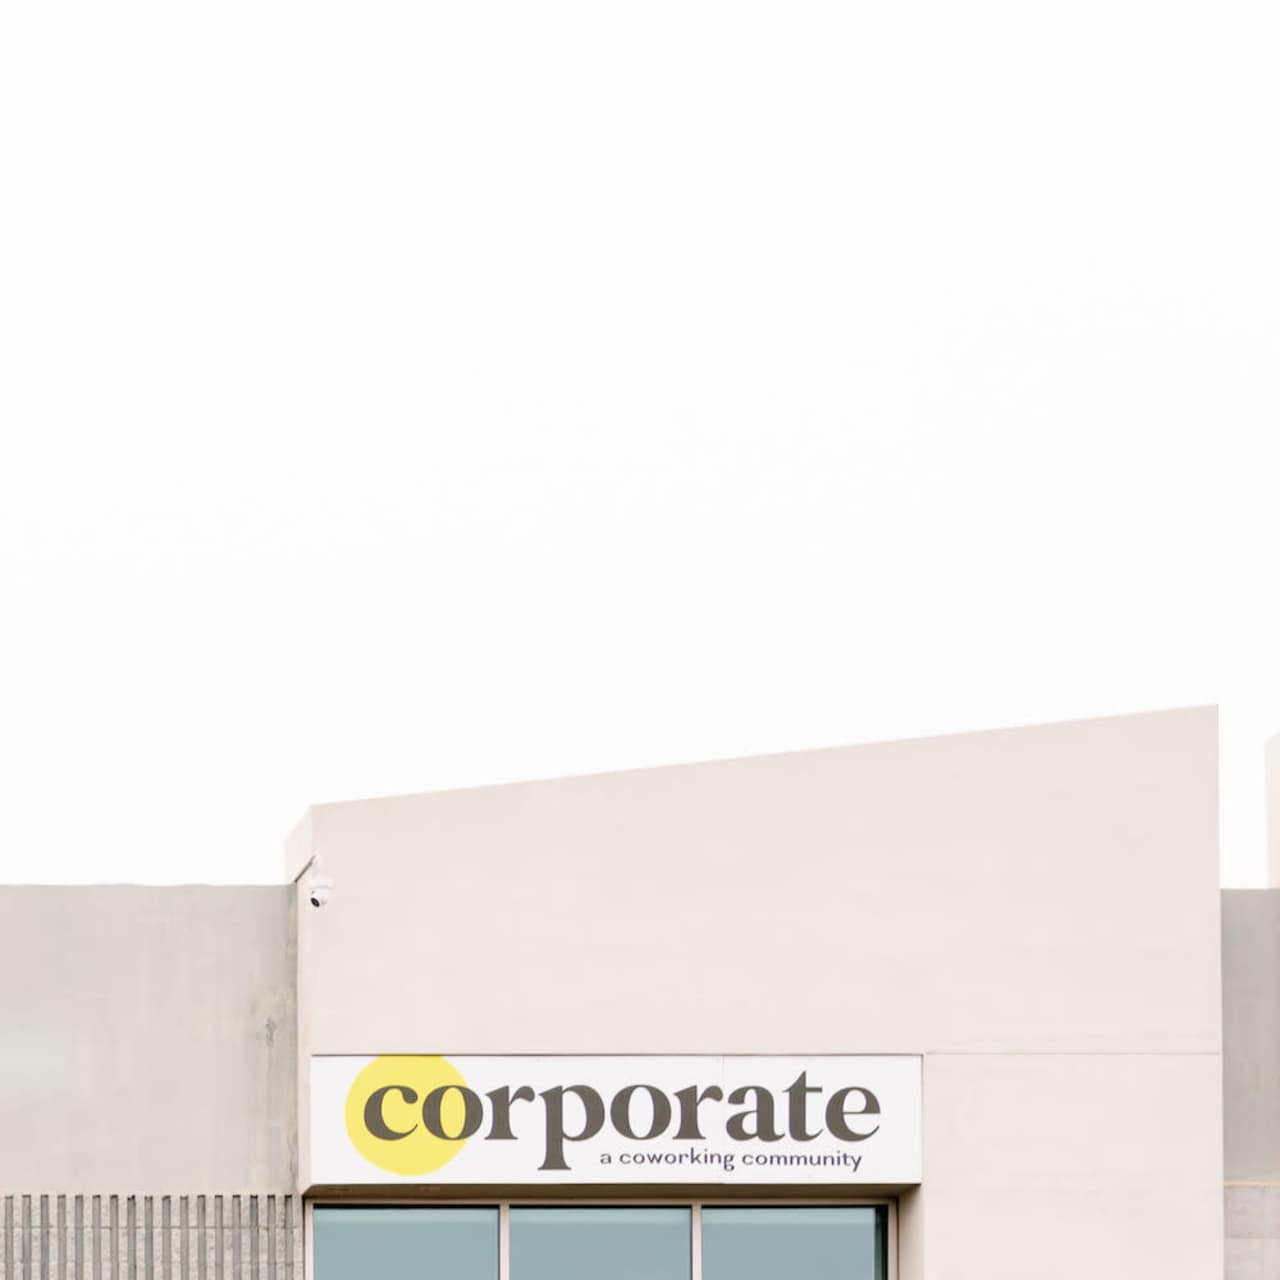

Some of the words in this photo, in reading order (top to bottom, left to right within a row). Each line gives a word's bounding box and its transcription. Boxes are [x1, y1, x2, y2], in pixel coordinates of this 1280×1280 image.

[364, 1071, 881, 1171] corporate
[600, 1153, 612, 1164] a
[619, 1147, 735, 1172] coworking
[741, 1149, 862, 1173] community
